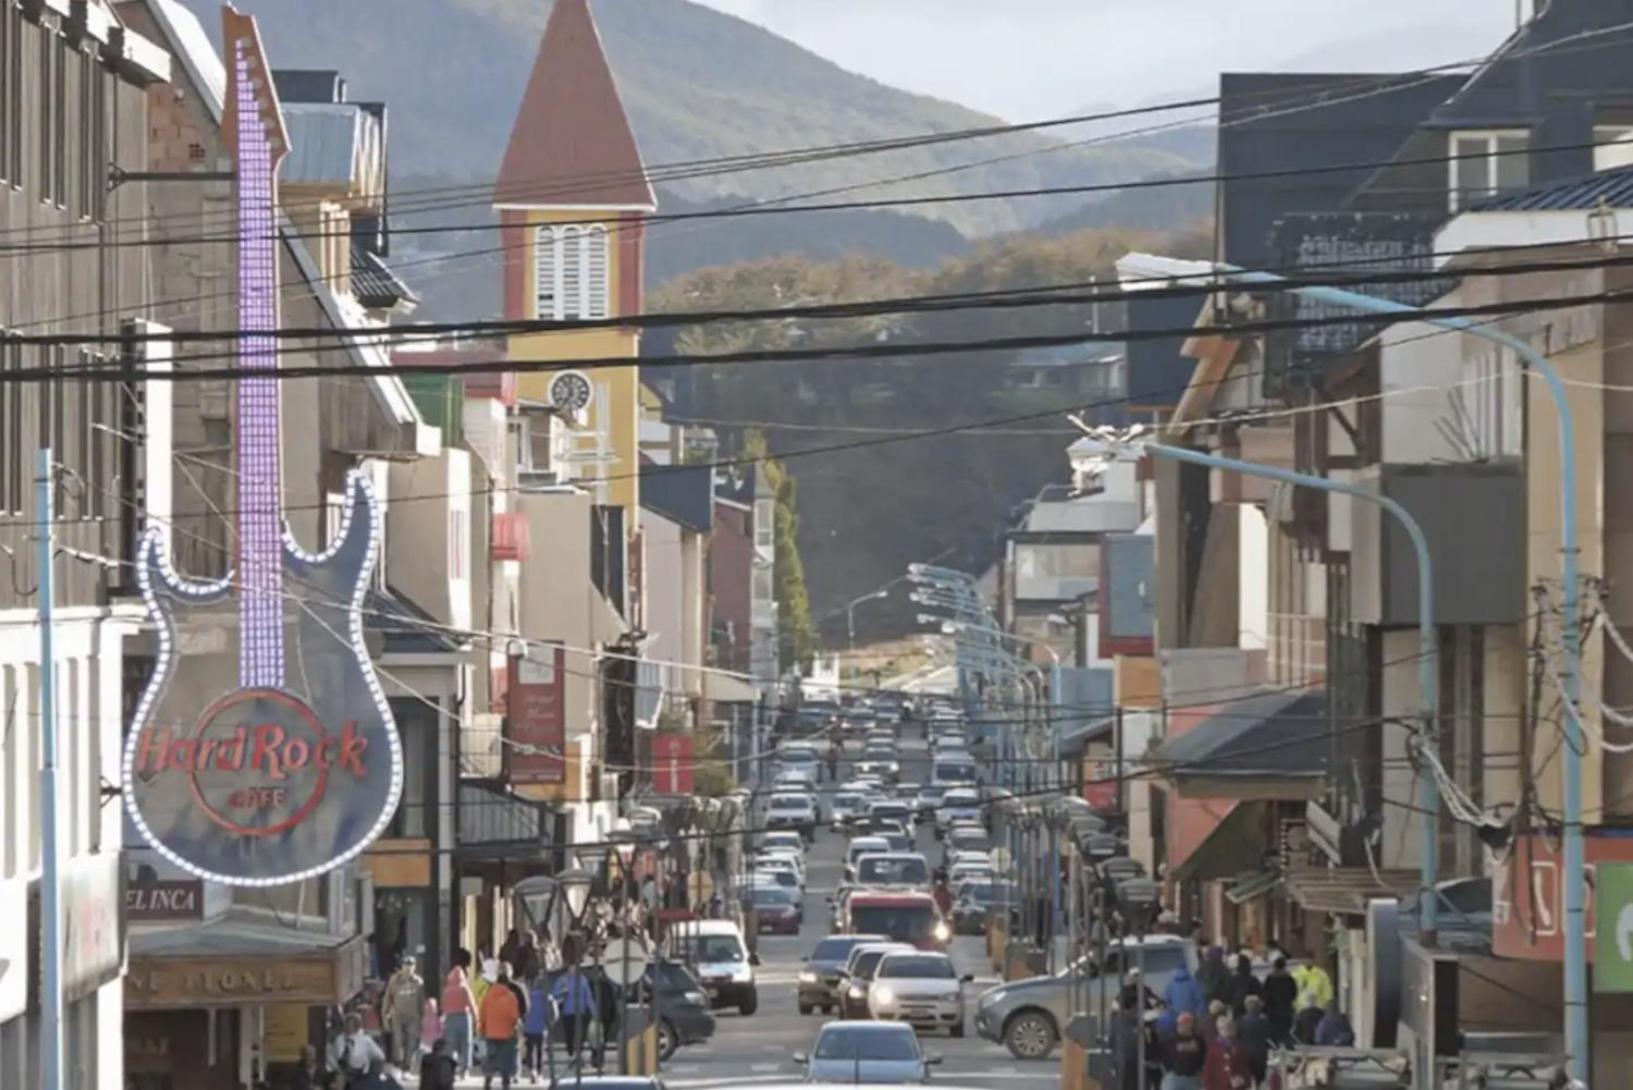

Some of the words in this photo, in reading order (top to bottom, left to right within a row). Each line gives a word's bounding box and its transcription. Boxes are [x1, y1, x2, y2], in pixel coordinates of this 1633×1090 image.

[134, 724, 247, 773] Hard
[252, 720, 369, 780] Rock
[150, 888, 194, 910] INCA
